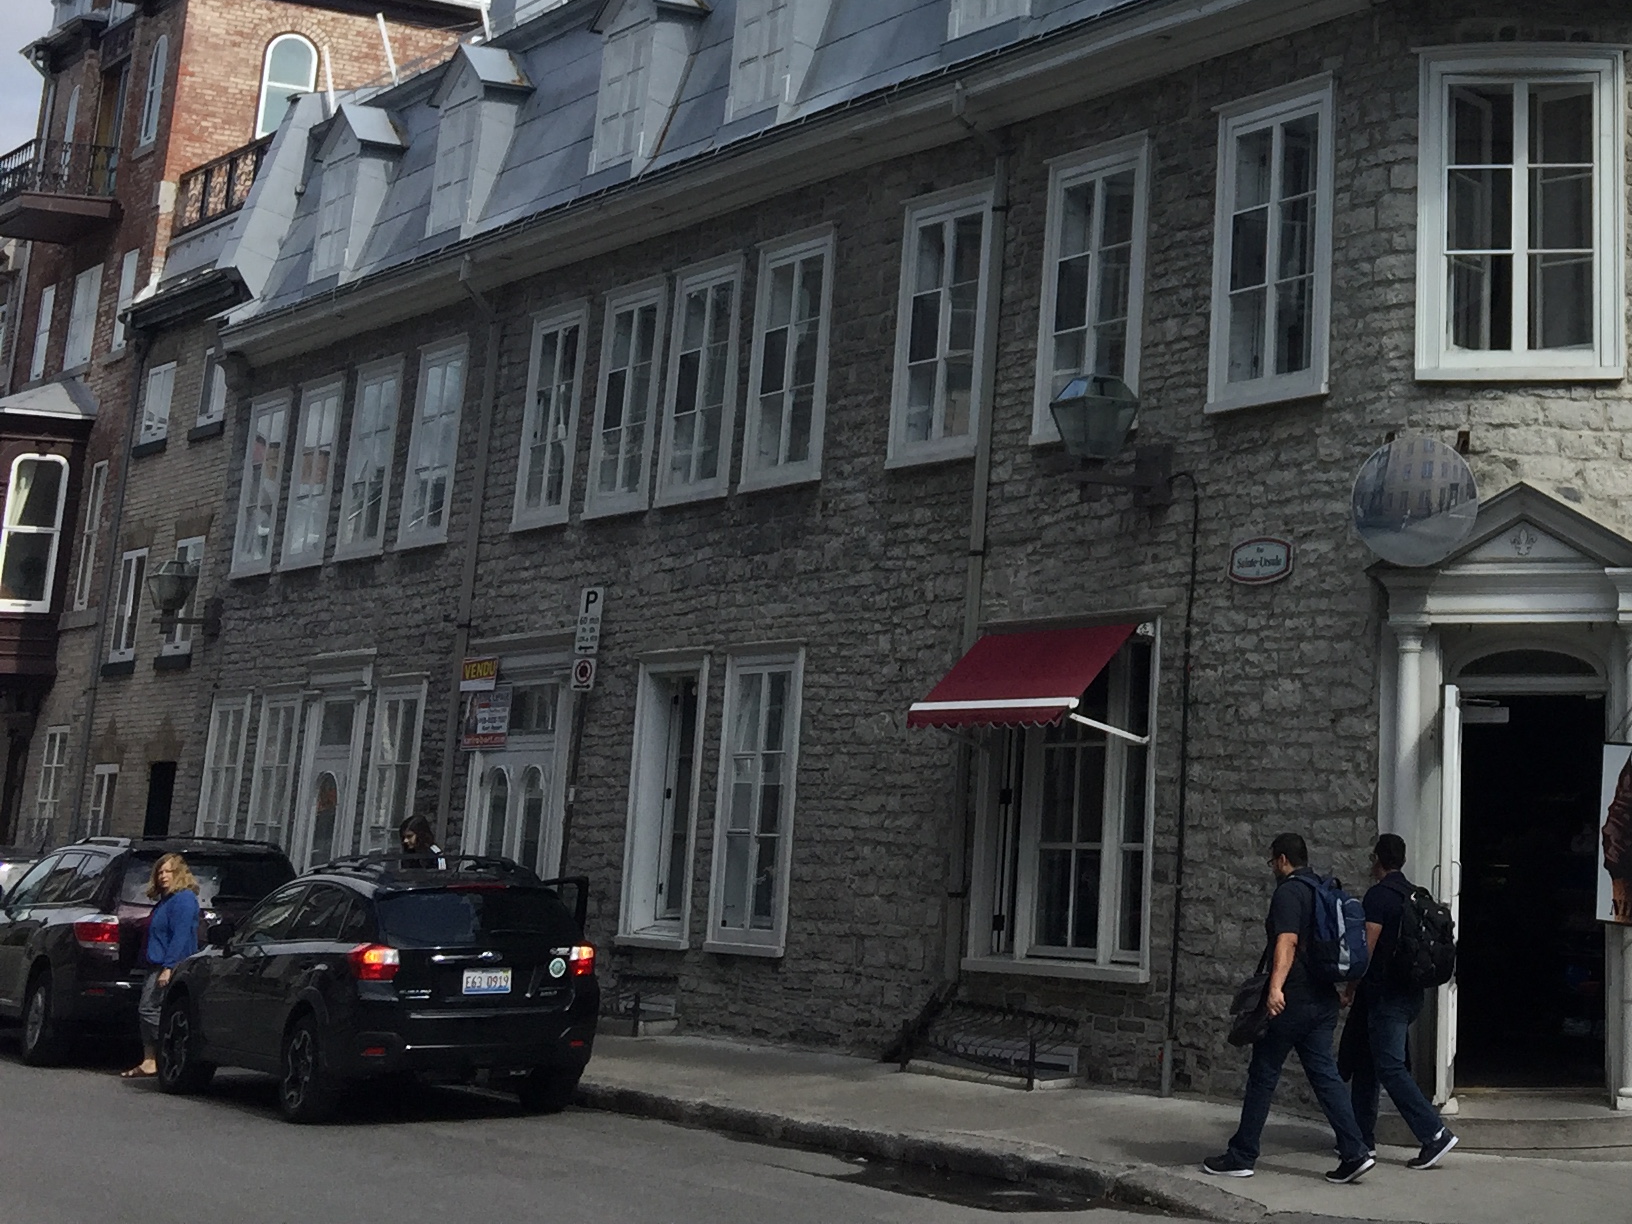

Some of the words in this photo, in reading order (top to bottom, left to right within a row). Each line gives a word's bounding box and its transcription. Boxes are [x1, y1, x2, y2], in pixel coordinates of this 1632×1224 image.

[585, 590, 598, 613] P
[465, 660, 496, 680] VENDU
[466, 976, 482, 988] E63
[486, 975, 509, 988] 0919
